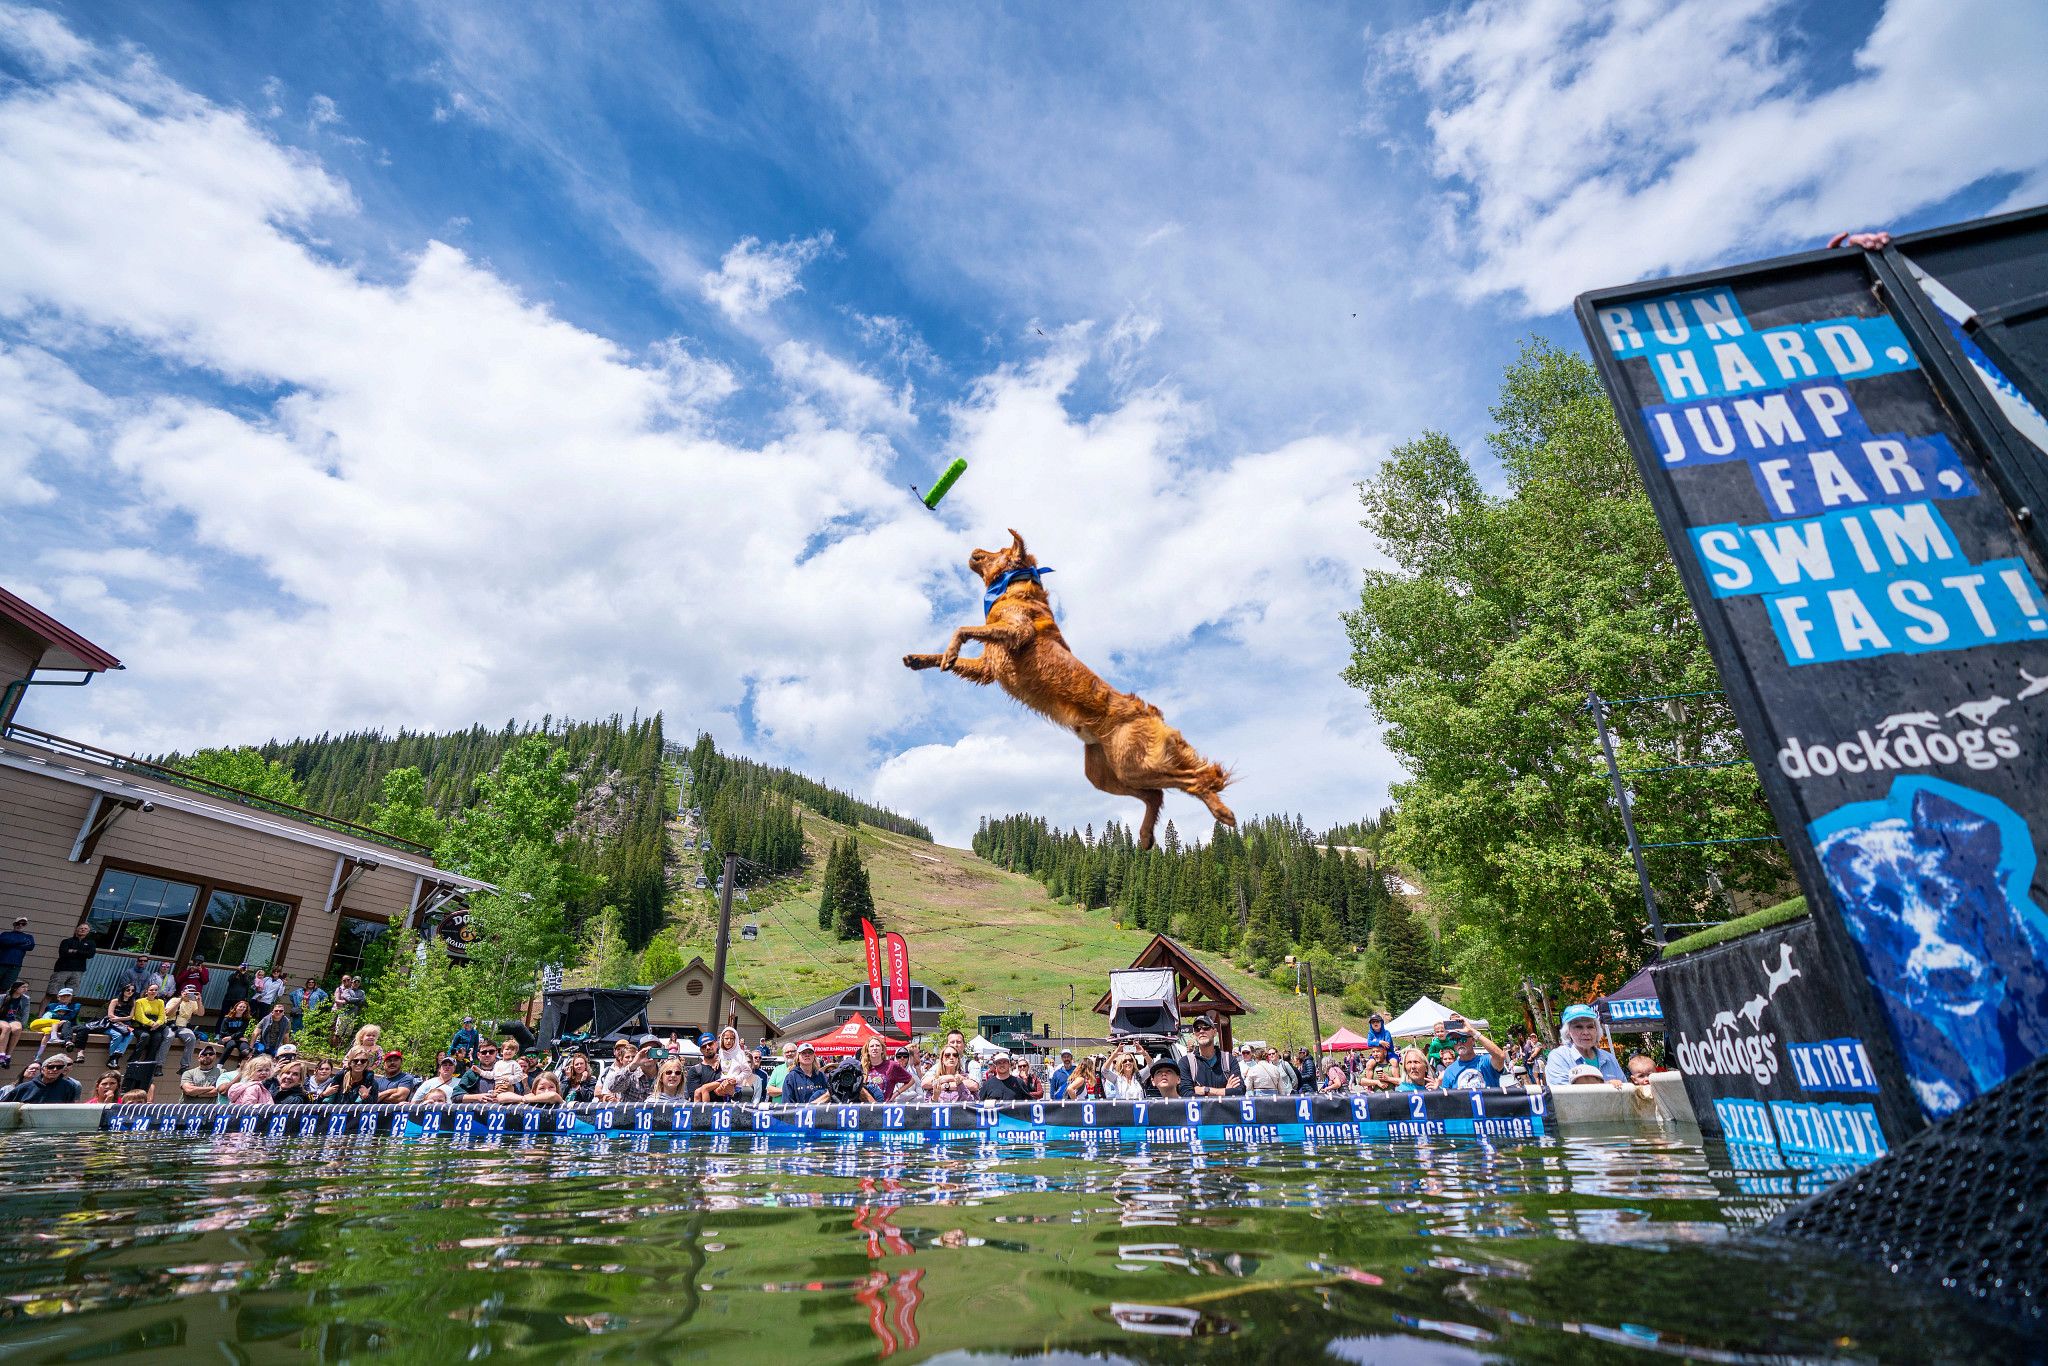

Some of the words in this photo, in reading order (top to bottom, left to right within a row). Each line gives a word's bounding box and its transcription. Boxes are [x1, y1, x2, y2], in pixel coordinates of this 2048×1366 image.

[1601, 294, 1745, 351] RUN
[1656, 325, 1909, 399] HARD,
[1655, 386, 1850, 463] JUMP
[1759, 440, 1963, 514] FAR,
[1699, 503, 1954, 590] SWIM
[1775, 570, 2048, 660] FAST!
[1777, 725, 2021, 779] dockdogs
[453, 914, 474, 926] DO
[837, 1015, 850, 1024] TH
[1676, 1027, 1778, 1086] dockdogs
[161, 1118, 176, 1132] 33
[188, 1118, 202, 1132] 32
[216, 1118, 229, 1134] 31
[241, 1117, 256, 1132] 30
[271, 1116, 286, 1132] 29
[301, 1118, 316, 1134] 28
[330, 1116, 346, 1132] 27
[361, 1114, 377, 1130] 26
[394, 1114, 408, 1130] 25
[424, 1114, 440, 1130] 24
[456, 1114, 472, 1131] 23
[488, 1114, 505, 1130] 22
[525, 1113, 539, 1130] 21
[558, 1112, 575, 1129] 20
[597, 1111, 613, 1129] 19
[636, 1112, 651, 1130] 18
[674, 1111, 691, 1128] 17
[714, 1110, 730, 1129] 16
[754, 1111, 770, 1128] 15
[796, 1110, 813, 1128] 14
[839, 1109, 857, 1128] 13
[884, 1108, 903, 1127] 12
[933, 1108, 949, 1126] 11
[978, 1108, 998, 1126] 10
[1033, 1103, 1044, 1124] 9
[1084, 1104, 1094, 1124] 8
[1135, 1103, 1146, 1123] 7
[1188, 1102, 1199, 1122] 6
[1242, 1100, 1254, 1120] 5
[1298, 1100, 1310, 1120] 4
[1354, 1098, 1368, 1119] 3
[1411, 1096, 1424, 1117] 2
[1472, 1093, 1483, 1115] 1
[1224, 1125, 1277, 1141] NOVICE
[1304, 1124, 1360, 1139] NOVICE
[1388, 1120, 1444, 1137] NOVICE
[1716, 1103, 1776, 1145] SPEED
[1772, 1104, 1886, 1158] RETRIEVE
